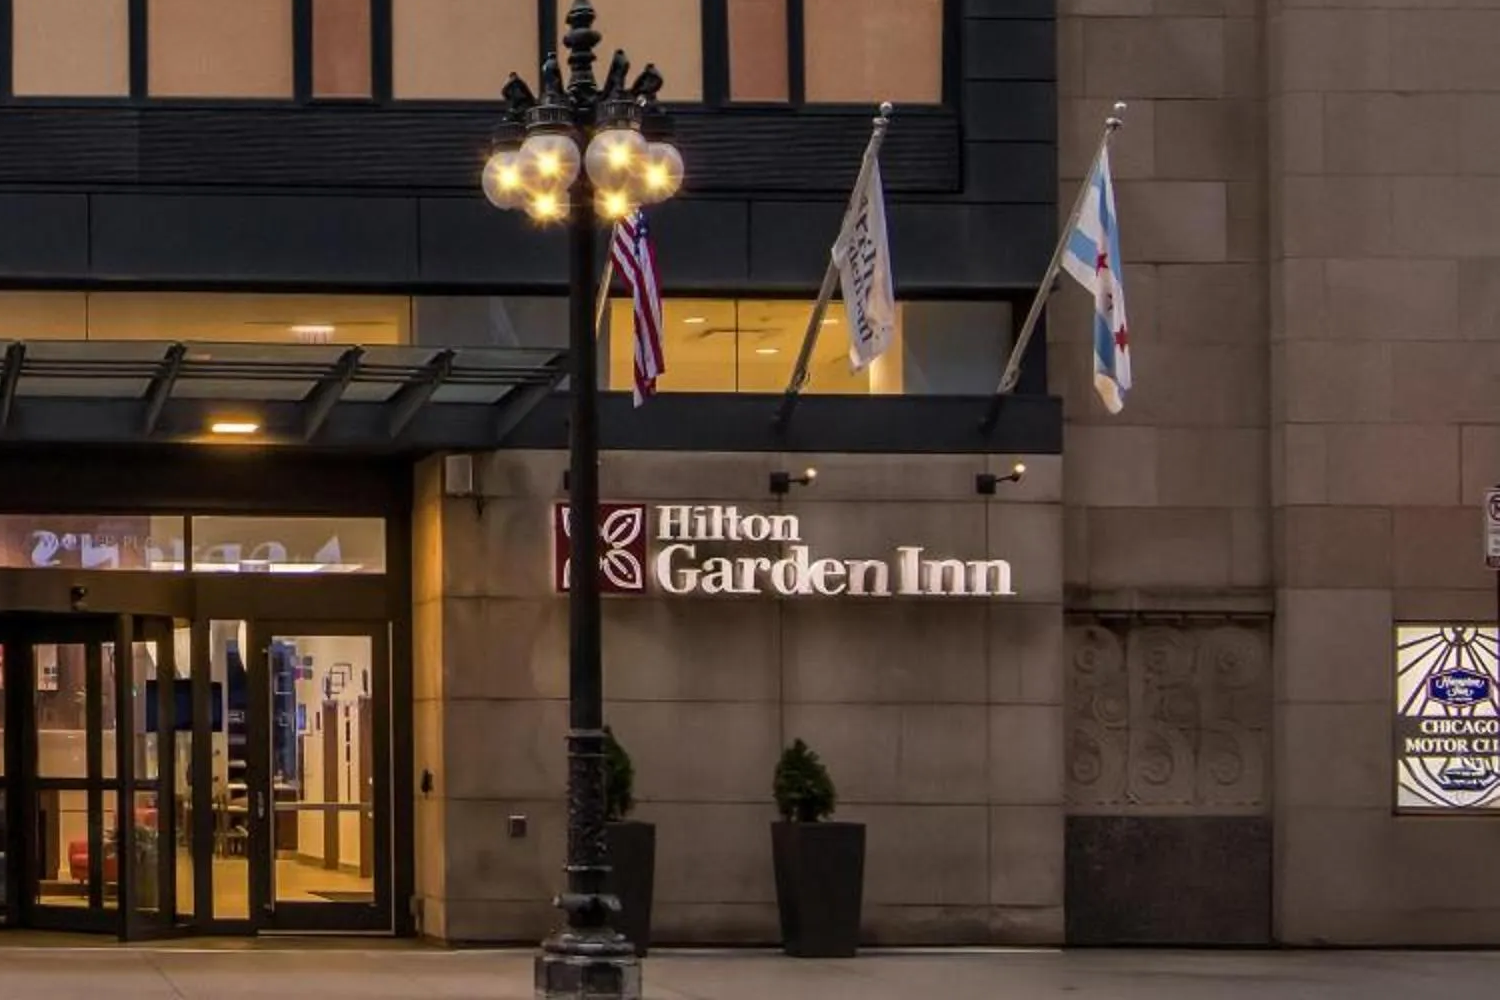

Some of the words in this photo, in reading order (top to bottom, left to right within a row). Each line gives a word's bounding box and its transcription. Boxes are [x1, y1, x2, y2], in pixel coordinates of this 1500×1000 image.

[656, 505, 802, 541] Hilton
[657, 543, 892, 595] Garden
[897, 546, 1017, 596] Inn
[1421, 720, 1499, 734] CHICAGO
[1405, 738, 1469, 753] MOTOR
